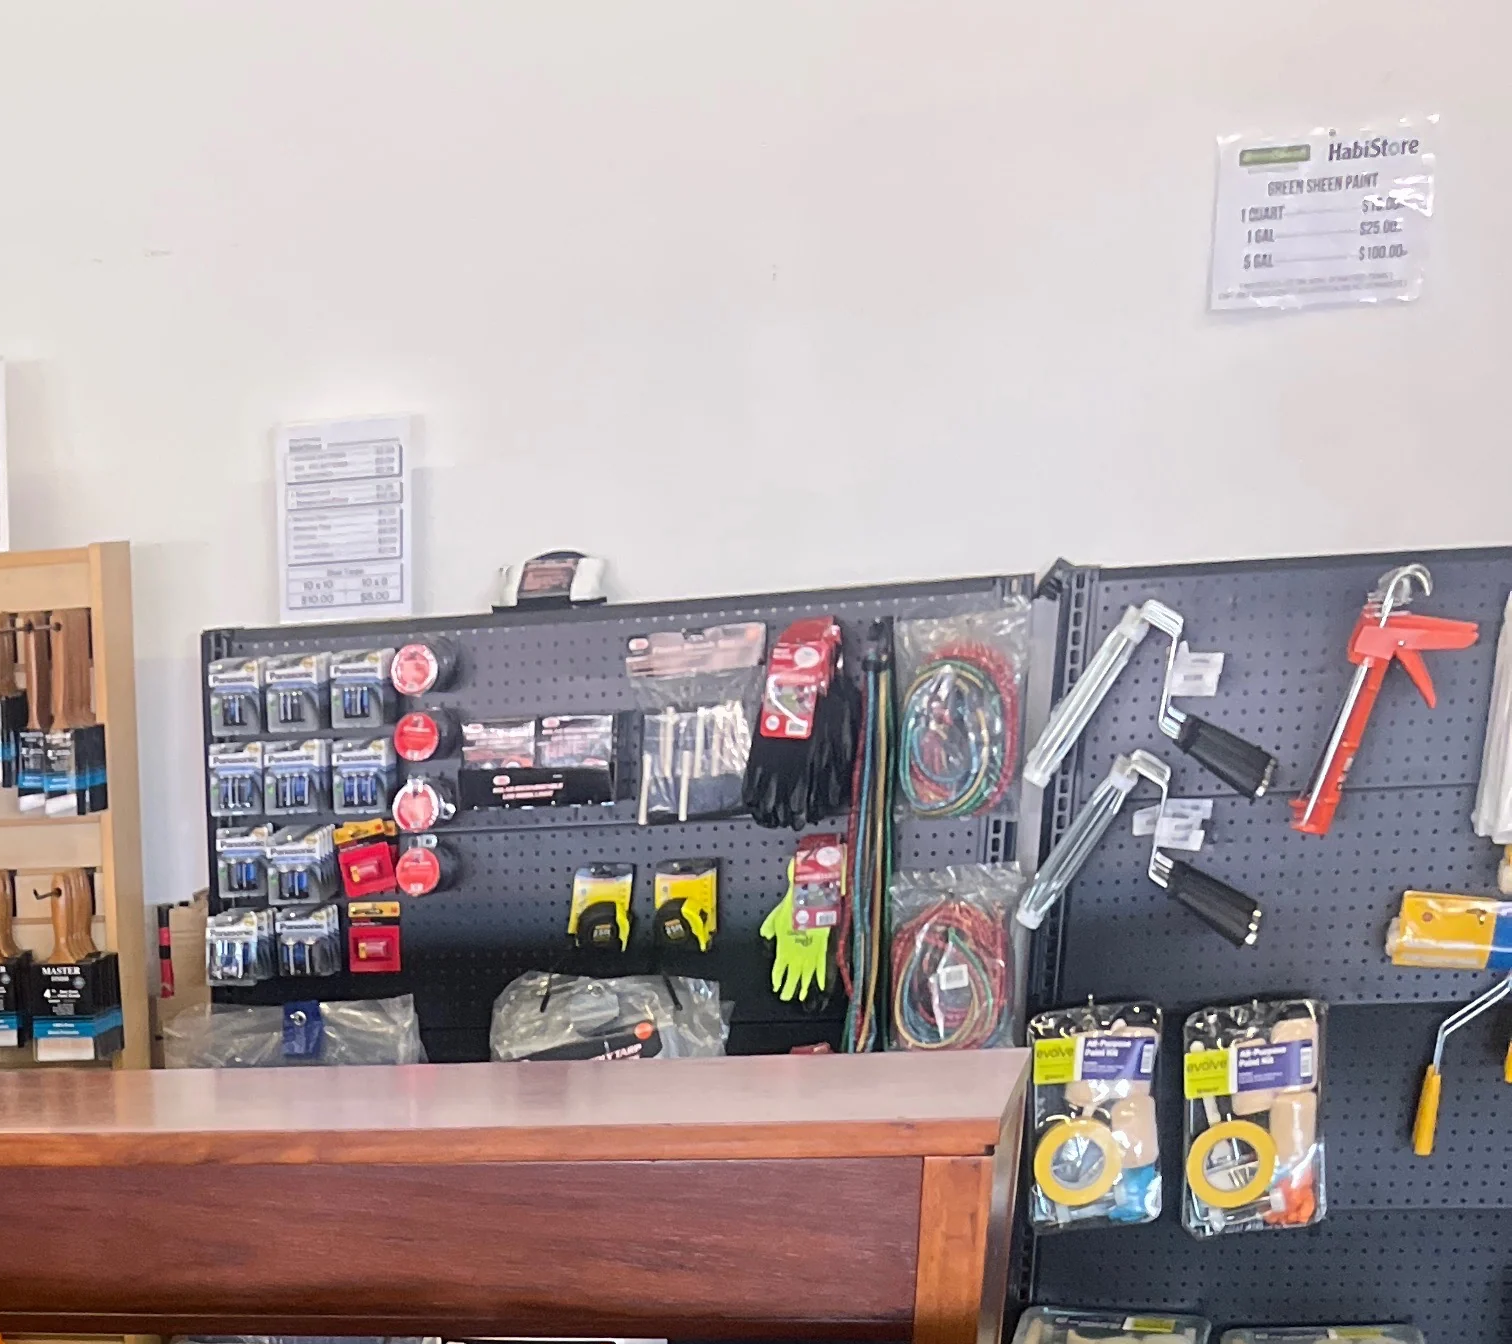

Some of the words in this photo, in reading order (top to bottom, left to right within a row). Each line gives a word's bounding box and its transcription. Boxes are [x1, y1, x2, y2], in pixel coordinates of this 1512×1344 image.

[1328, 138, 1419, 161] HabiStore
[1268, 179, 1304, 197] GREEN
[1306, 176, 1342, 194] SHEEN
[1345, 172, 1379, 190] PAINT
[1248, 205, 1285, 222] QUART
[1255, 228, 1275, 244] GAL
[1254, 253, 1274, 269] GAL
[41, 966, 81, 975] MASTER
[1036, 1045, 1074, 1059] evolve
[1186, 1058, 1228, 1072] evolve
